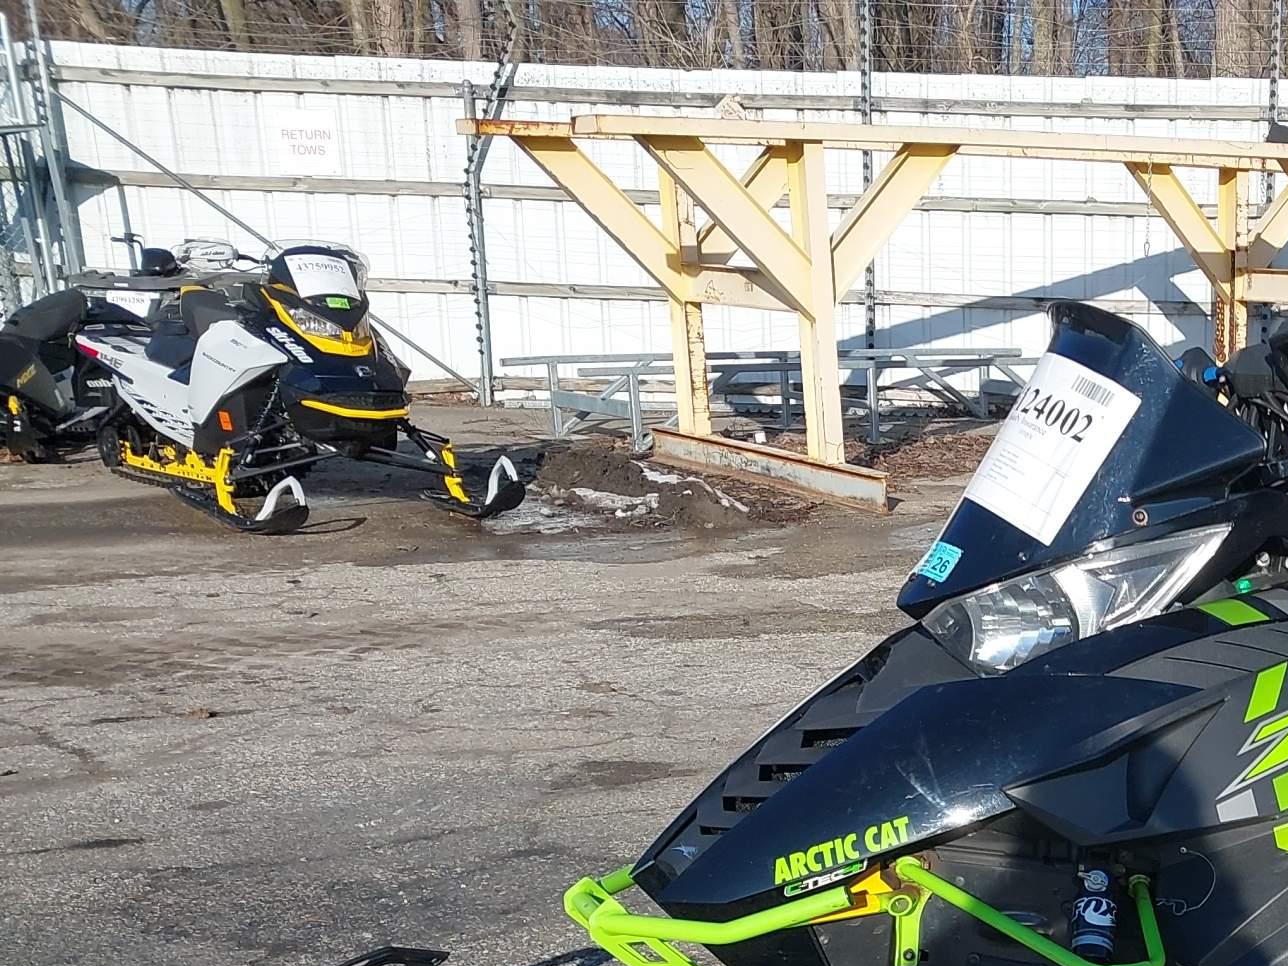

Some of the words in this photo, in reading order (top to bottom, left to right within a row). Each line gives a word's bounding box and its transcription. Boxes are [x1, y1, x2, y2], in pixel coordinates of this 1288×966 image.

[280, 129, 332, 141] RETURN
[290, 144, 327, 156] TOWS
[265, 326, 314, 363] ski-doo
[931, 557, 950, 574] 26
[774, 833, 860, 885] ARCTIC
[864, 816, 909, 853] CAT
